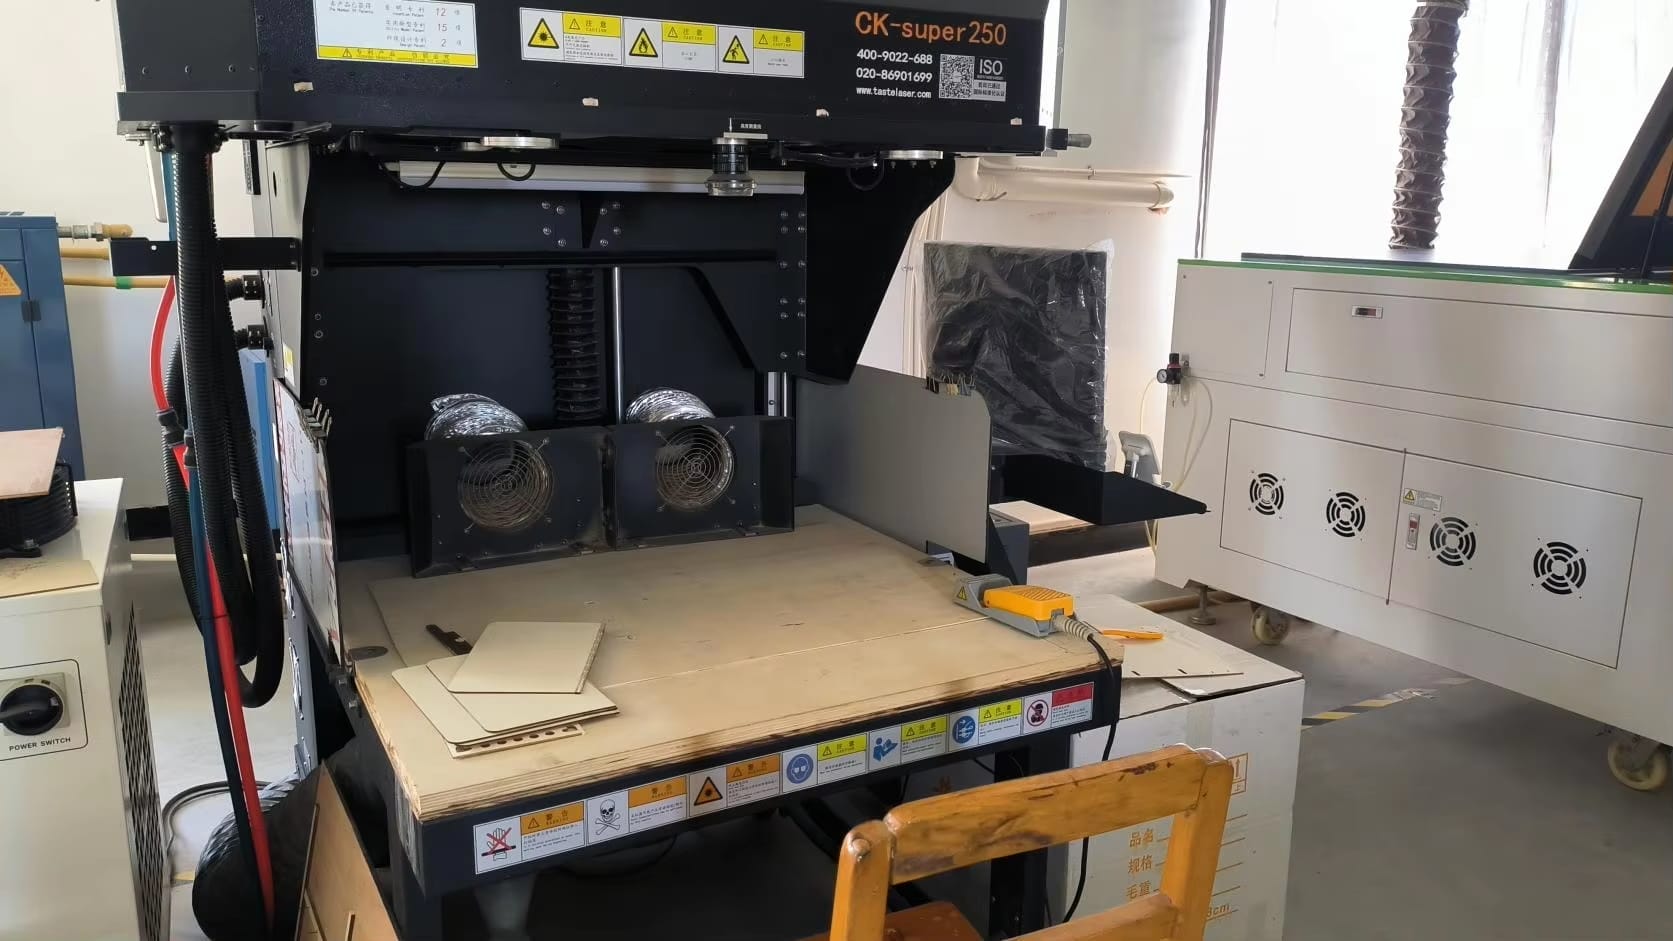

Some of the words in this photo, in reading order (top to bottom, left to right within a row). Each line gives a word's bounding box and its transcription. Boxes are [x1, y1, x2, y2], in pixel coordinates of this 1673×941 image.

[435, 7, 447, 17] 12
[438, 23, 448, 32] 15
[855, 10, 1006, 46] CK-super250
[441, 38, 447, 47] 2
[856, 49, 933, 65] 400-9022-688
[856, 67, 933, 83] 020-86901699
[979, 58, 1003, 76] ISO
[856, 86, 932, 99] www.tastelaser.com
[9, 742, 37, 752] POWER
[40, 737, 71, 747] SWITCH
[1129, 828, 1154, 848] 品名
[1127, 855, 1152, 875] 规格
[1126, 880, 1151, 900] 毛重
